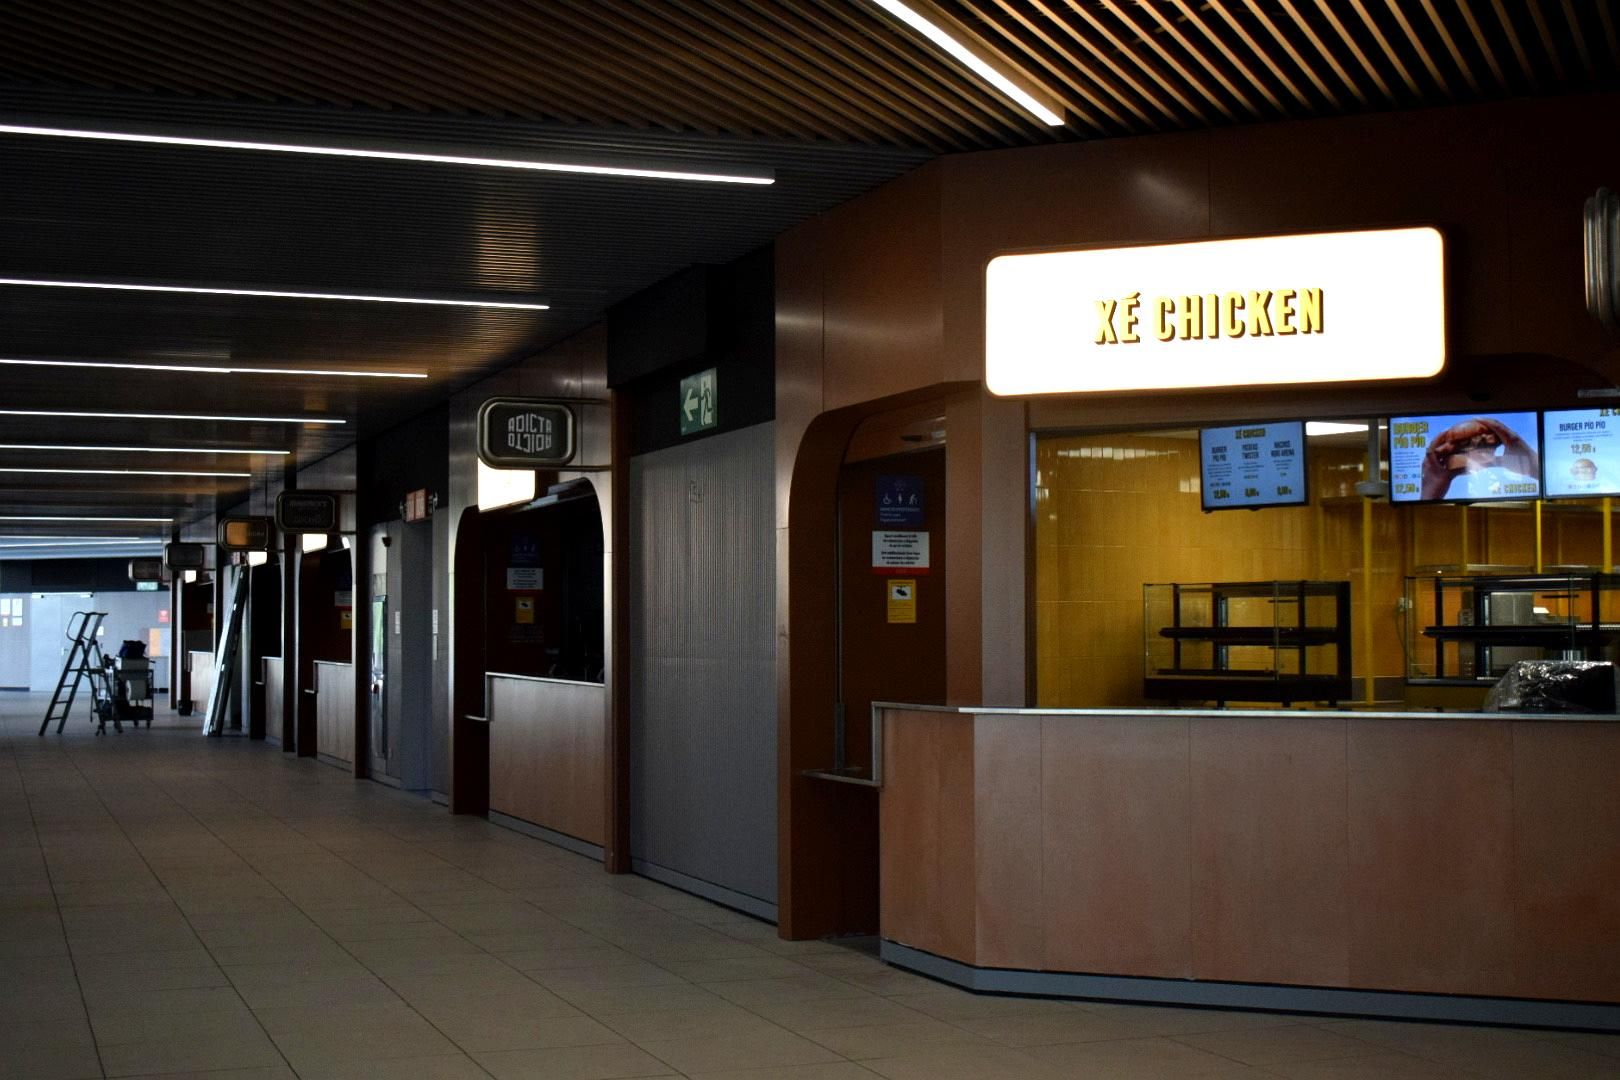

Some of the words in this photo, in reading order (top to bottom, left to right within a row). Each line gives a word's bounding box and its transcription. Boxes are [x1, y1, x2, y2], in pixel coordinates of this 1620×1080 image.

[1094, 291, 1142, 345] XÉ
[1153, 287, 1324, 343] CHICKEN
[508, 413, 552, 433] ADICTA
[1559, 422, 1583, 432] BURGER
